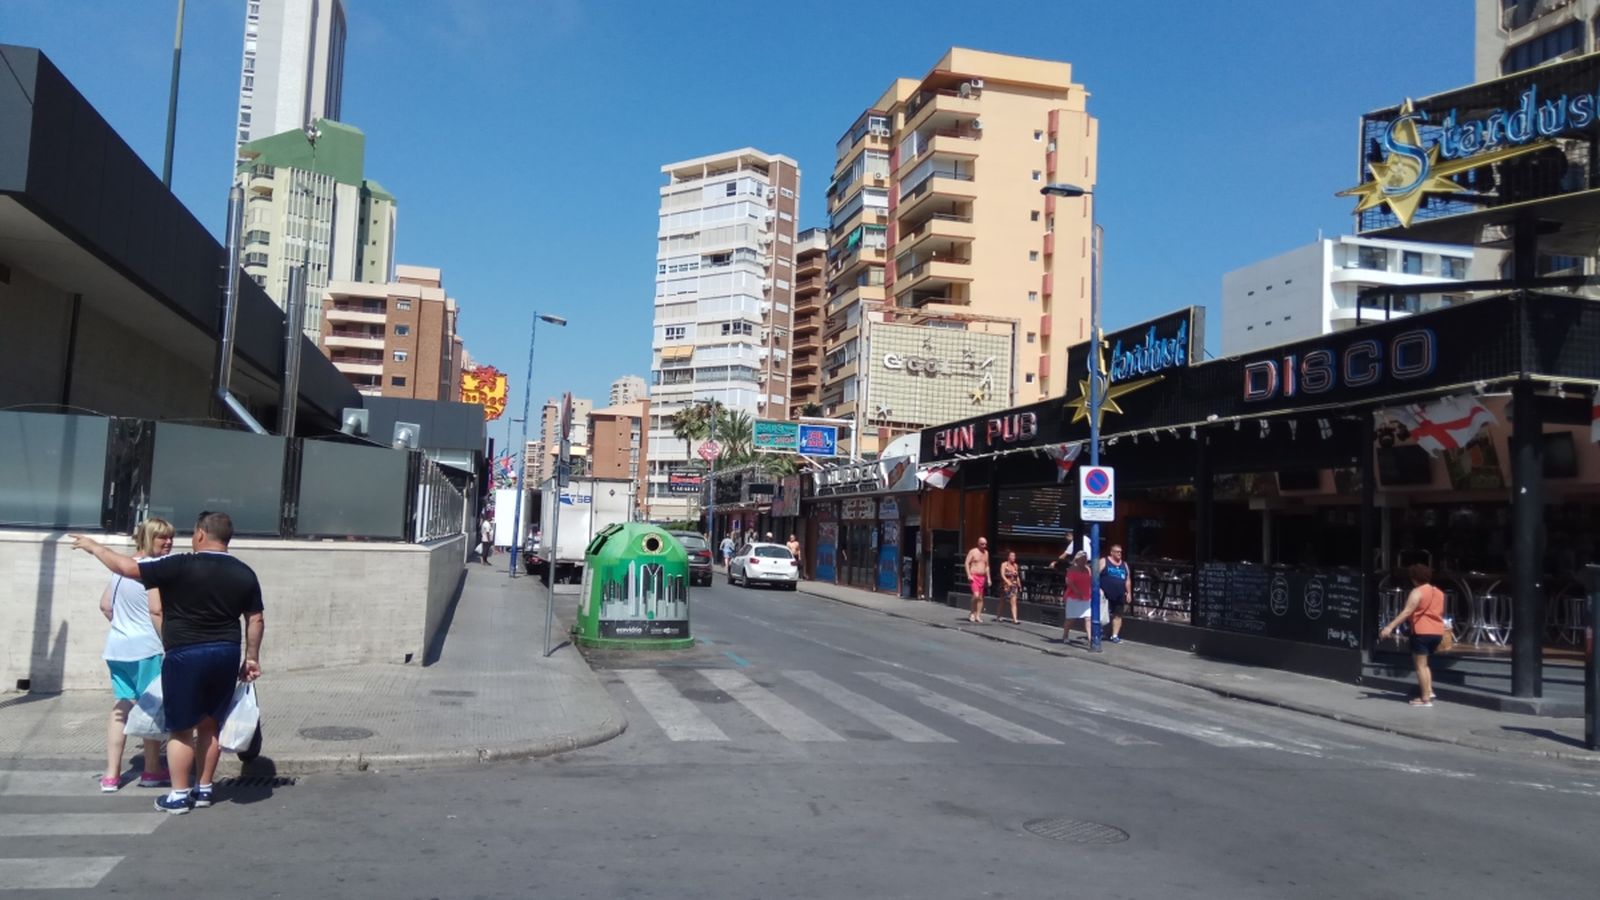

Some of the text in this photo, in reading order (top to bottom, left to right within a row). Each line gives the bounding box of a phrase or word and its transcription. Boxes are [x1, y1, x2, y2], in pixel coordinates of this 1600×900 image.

[1382, 83, 1600, 196] Stardus
[1244, 328, 1438, 402] DISCO
[933, 412, 1037, 457] FUN PUB
